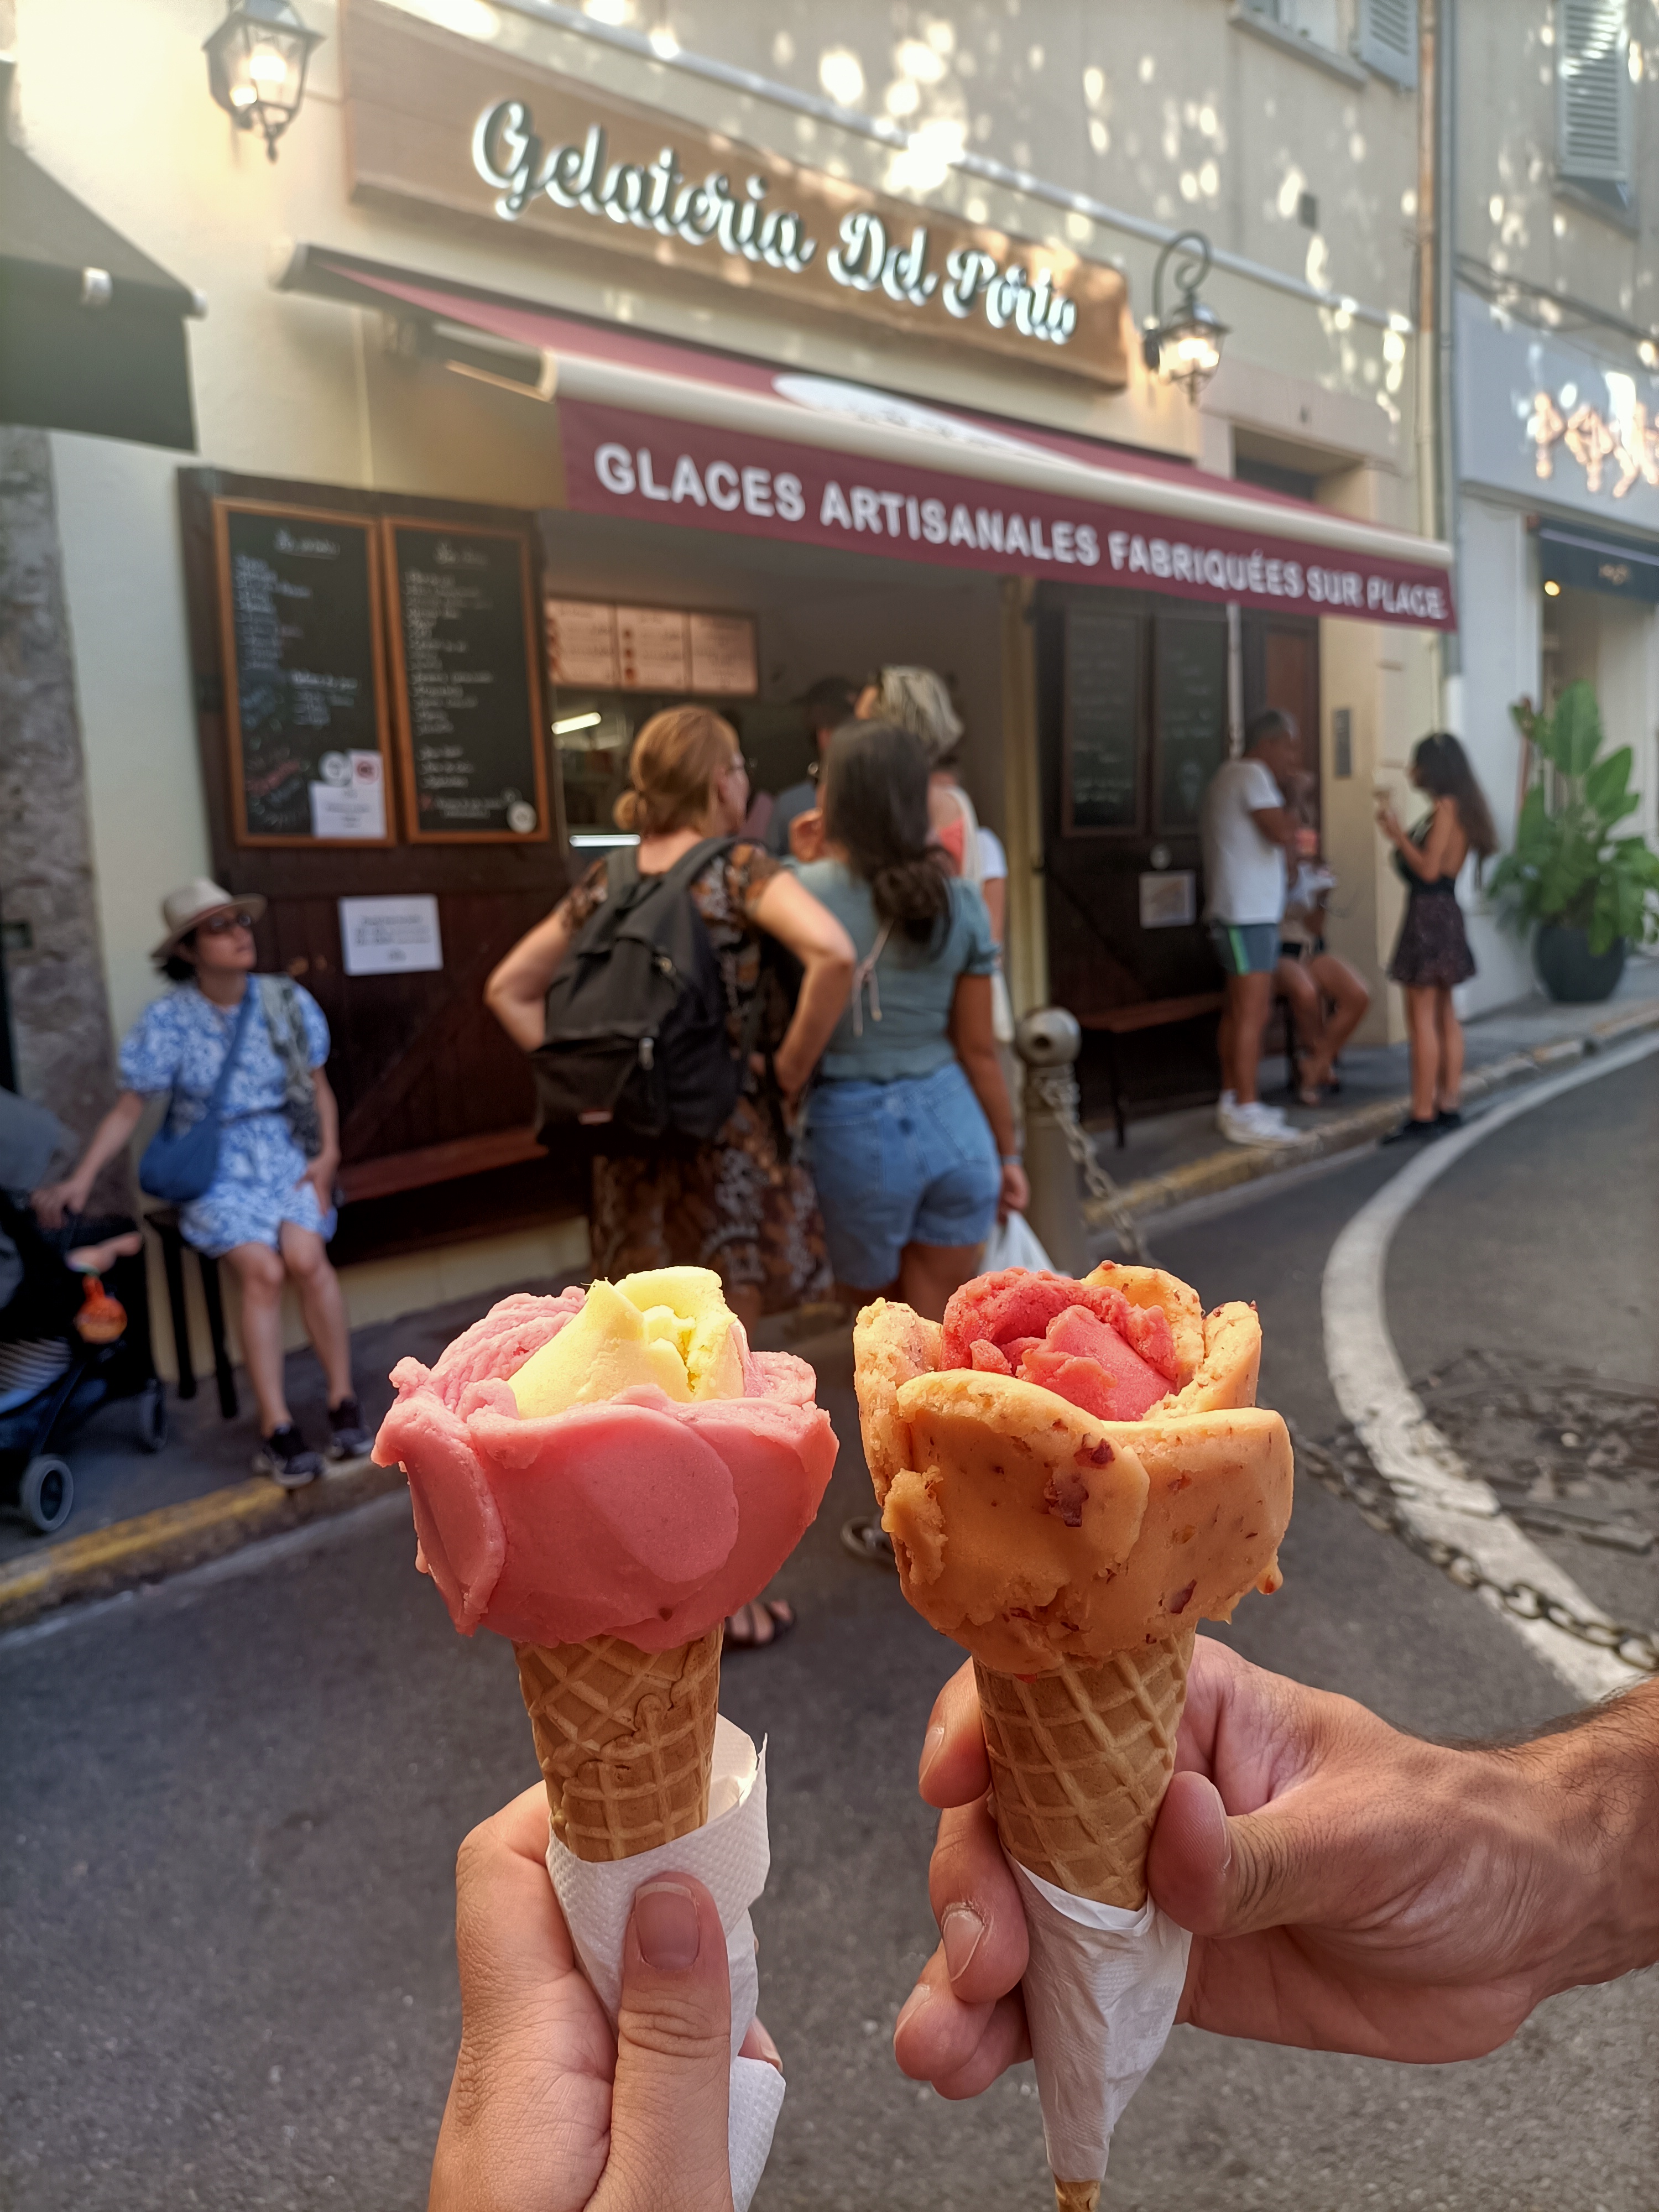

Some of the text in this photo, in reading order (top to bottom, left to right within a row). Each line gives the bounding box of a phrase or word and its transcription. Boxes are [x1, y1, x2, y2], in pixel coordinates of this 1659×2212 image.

[471, 101, 1077, 345] Gelateria Del Porto
[594, 442, 1449, 620] GLACES ARTISANALES FABRIQUÉES SUR PLACE
